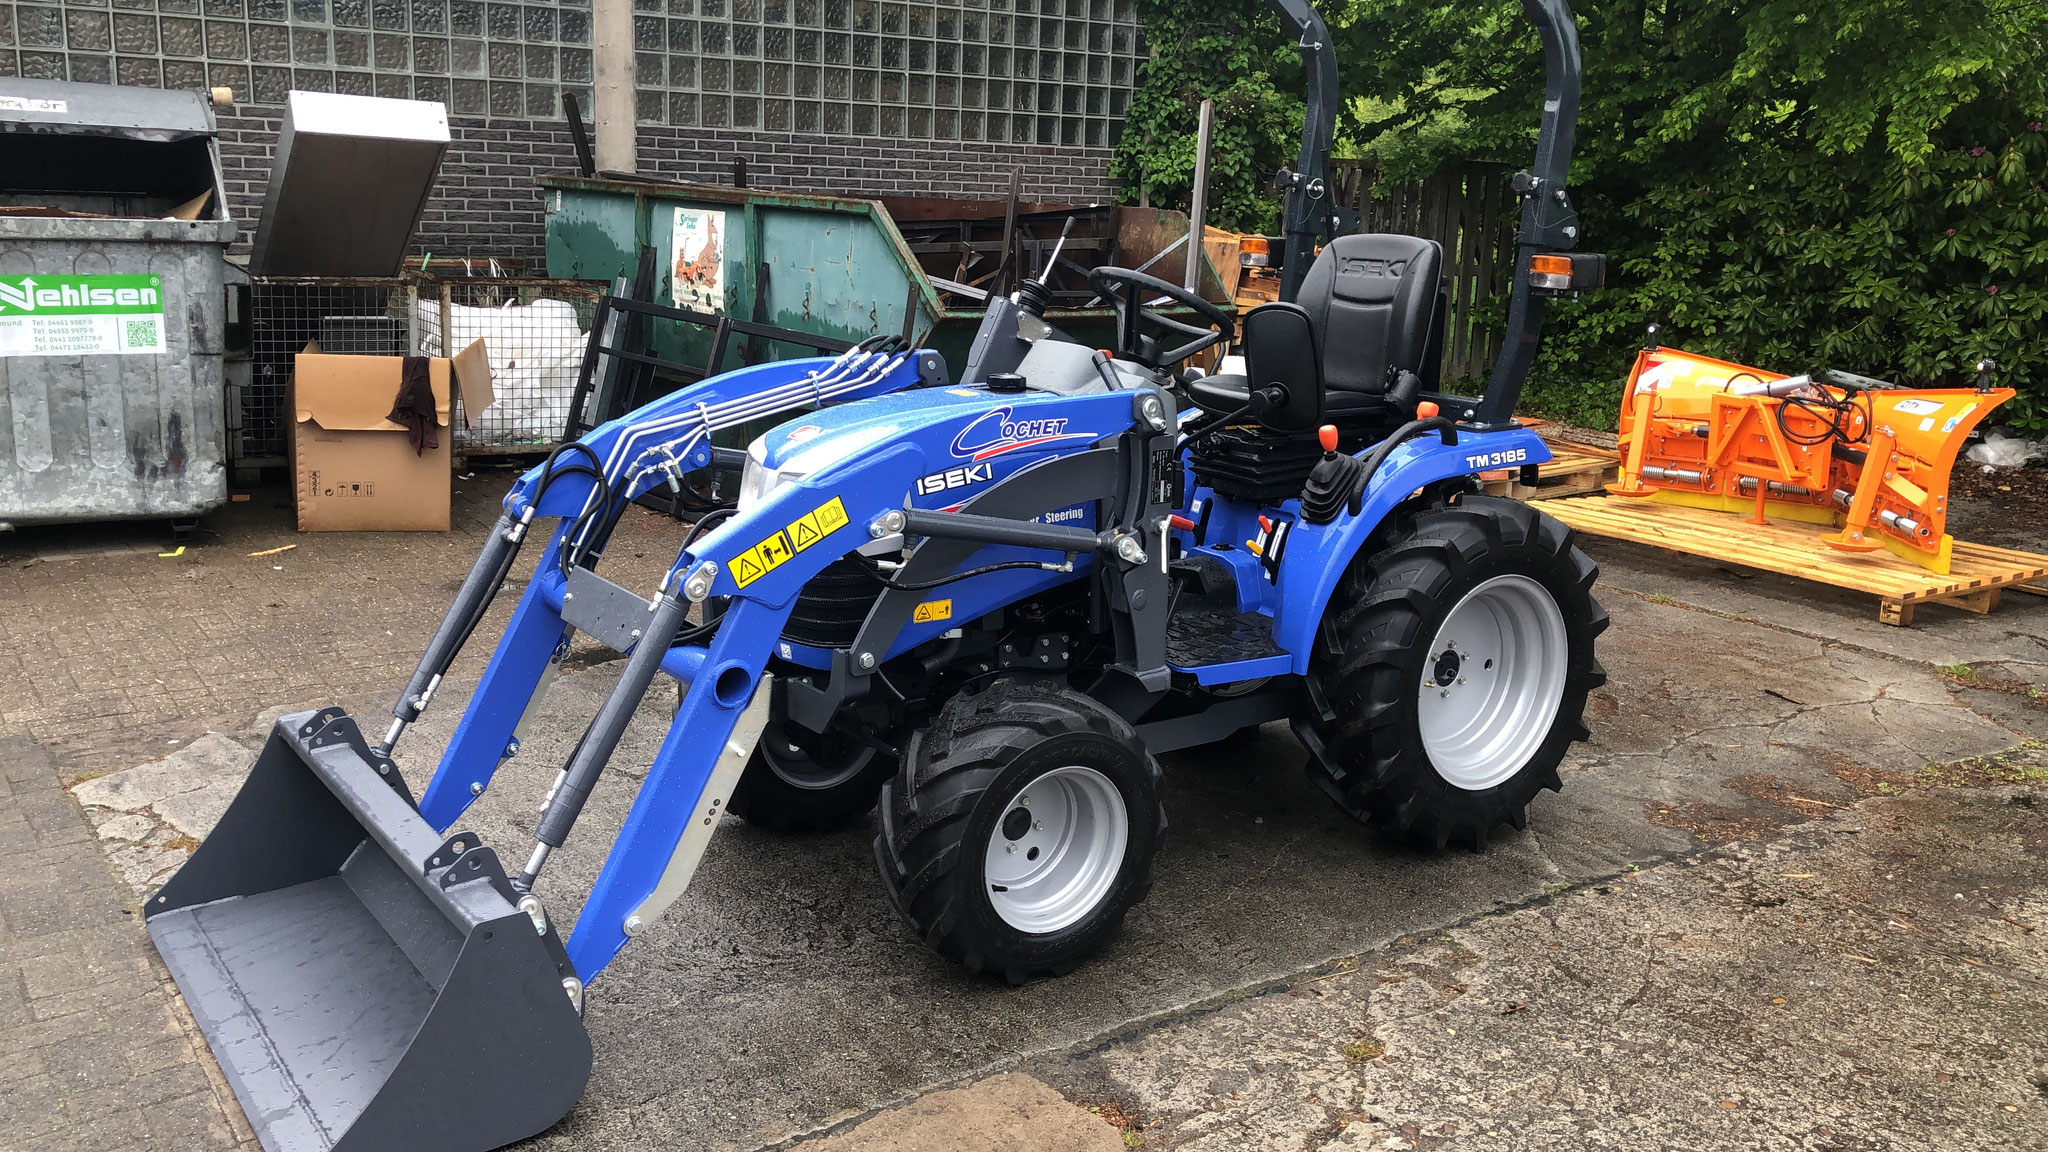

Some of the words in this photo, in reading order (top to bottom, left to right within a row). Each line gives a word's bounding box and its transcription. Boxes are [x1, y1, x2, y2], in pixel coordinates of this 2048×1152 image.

[950, 405, 1068, 458] COCHET
[1465, 453, 1491, 469] TM
[1491, 448, 1527, 466] 3185
[916, 462, 993, 496] ISEKI
[1045, 508, 1083, 524] Steering
